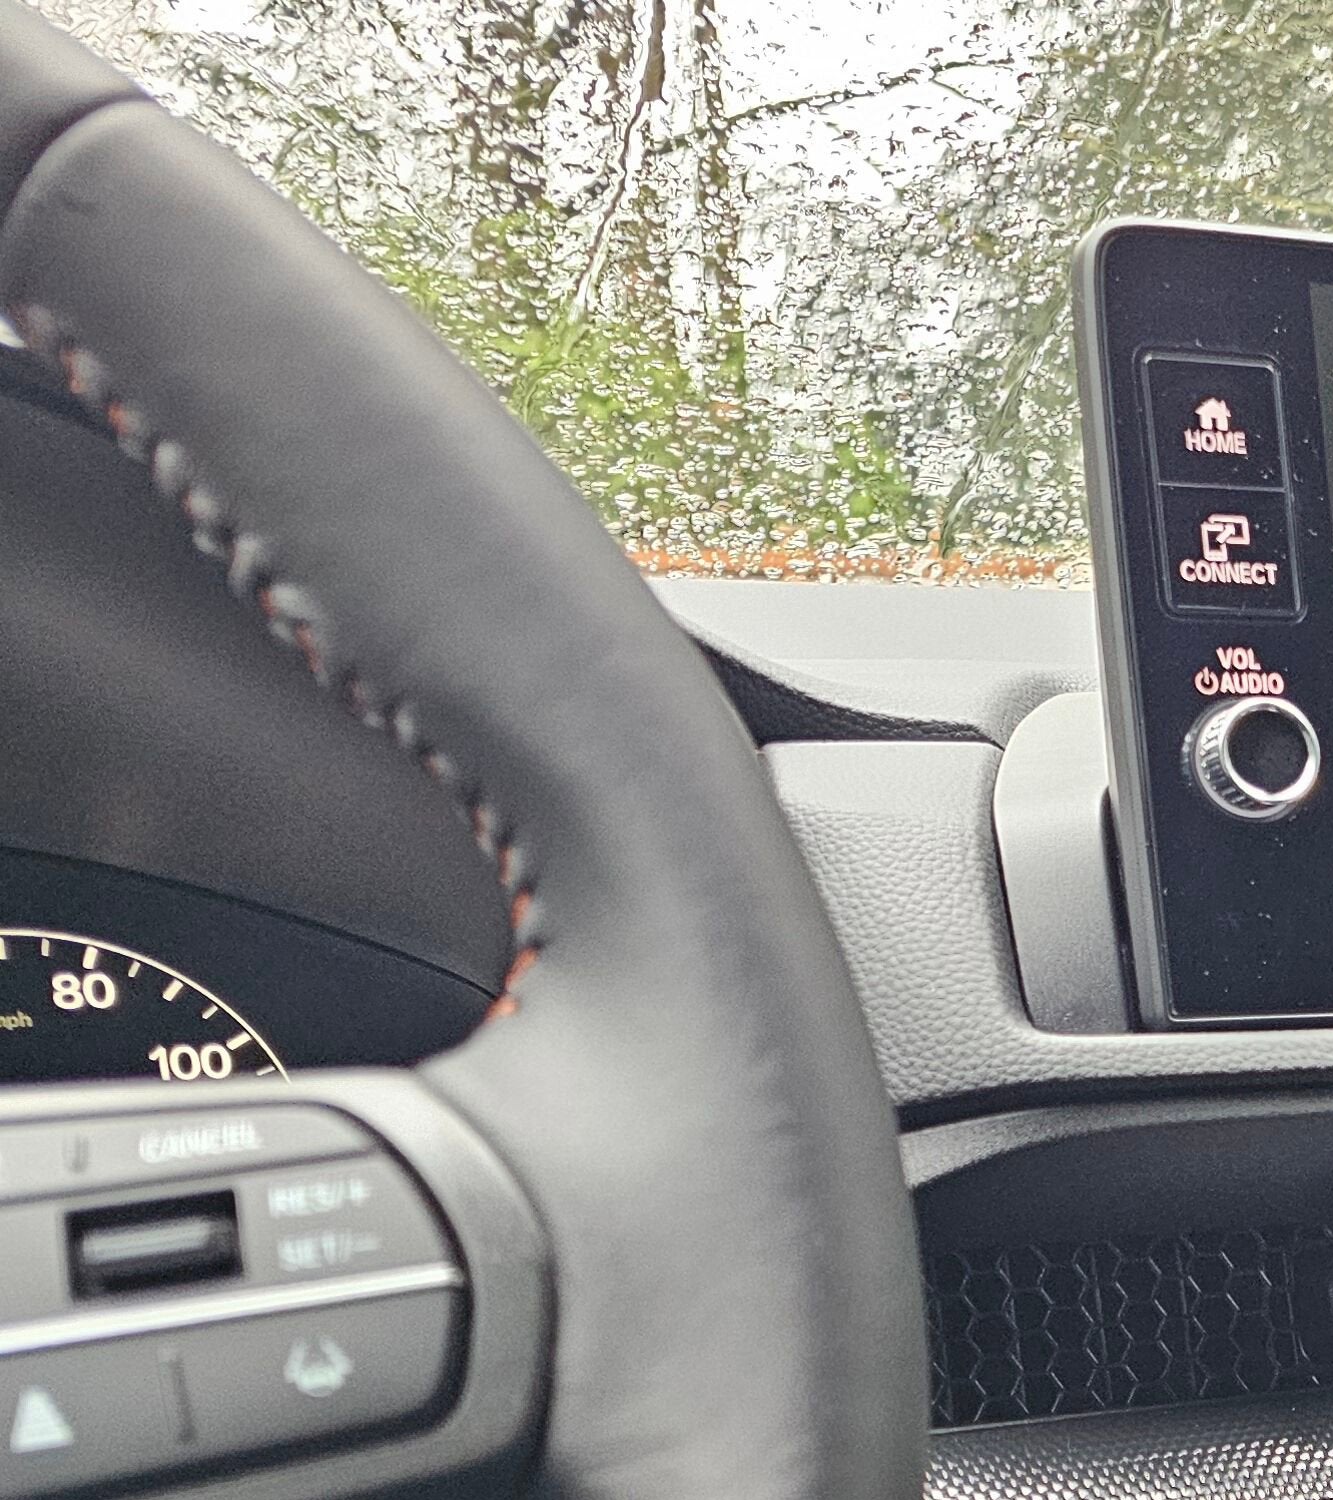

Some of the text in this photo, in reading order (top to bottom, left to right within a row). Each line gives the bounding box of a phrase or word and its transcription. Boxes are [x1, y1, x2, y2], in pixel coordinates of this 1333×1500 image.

[1184, 428, 1247, 455] HOME
[1179, 558, 1278, 586] CONNECT
[1216, 647, 1261, 671] VOL
[1220, 671, 1284, 695] AUDIO
[51, 971, 117, 1011] 80
[148, 1043, 233, 1082] 100
